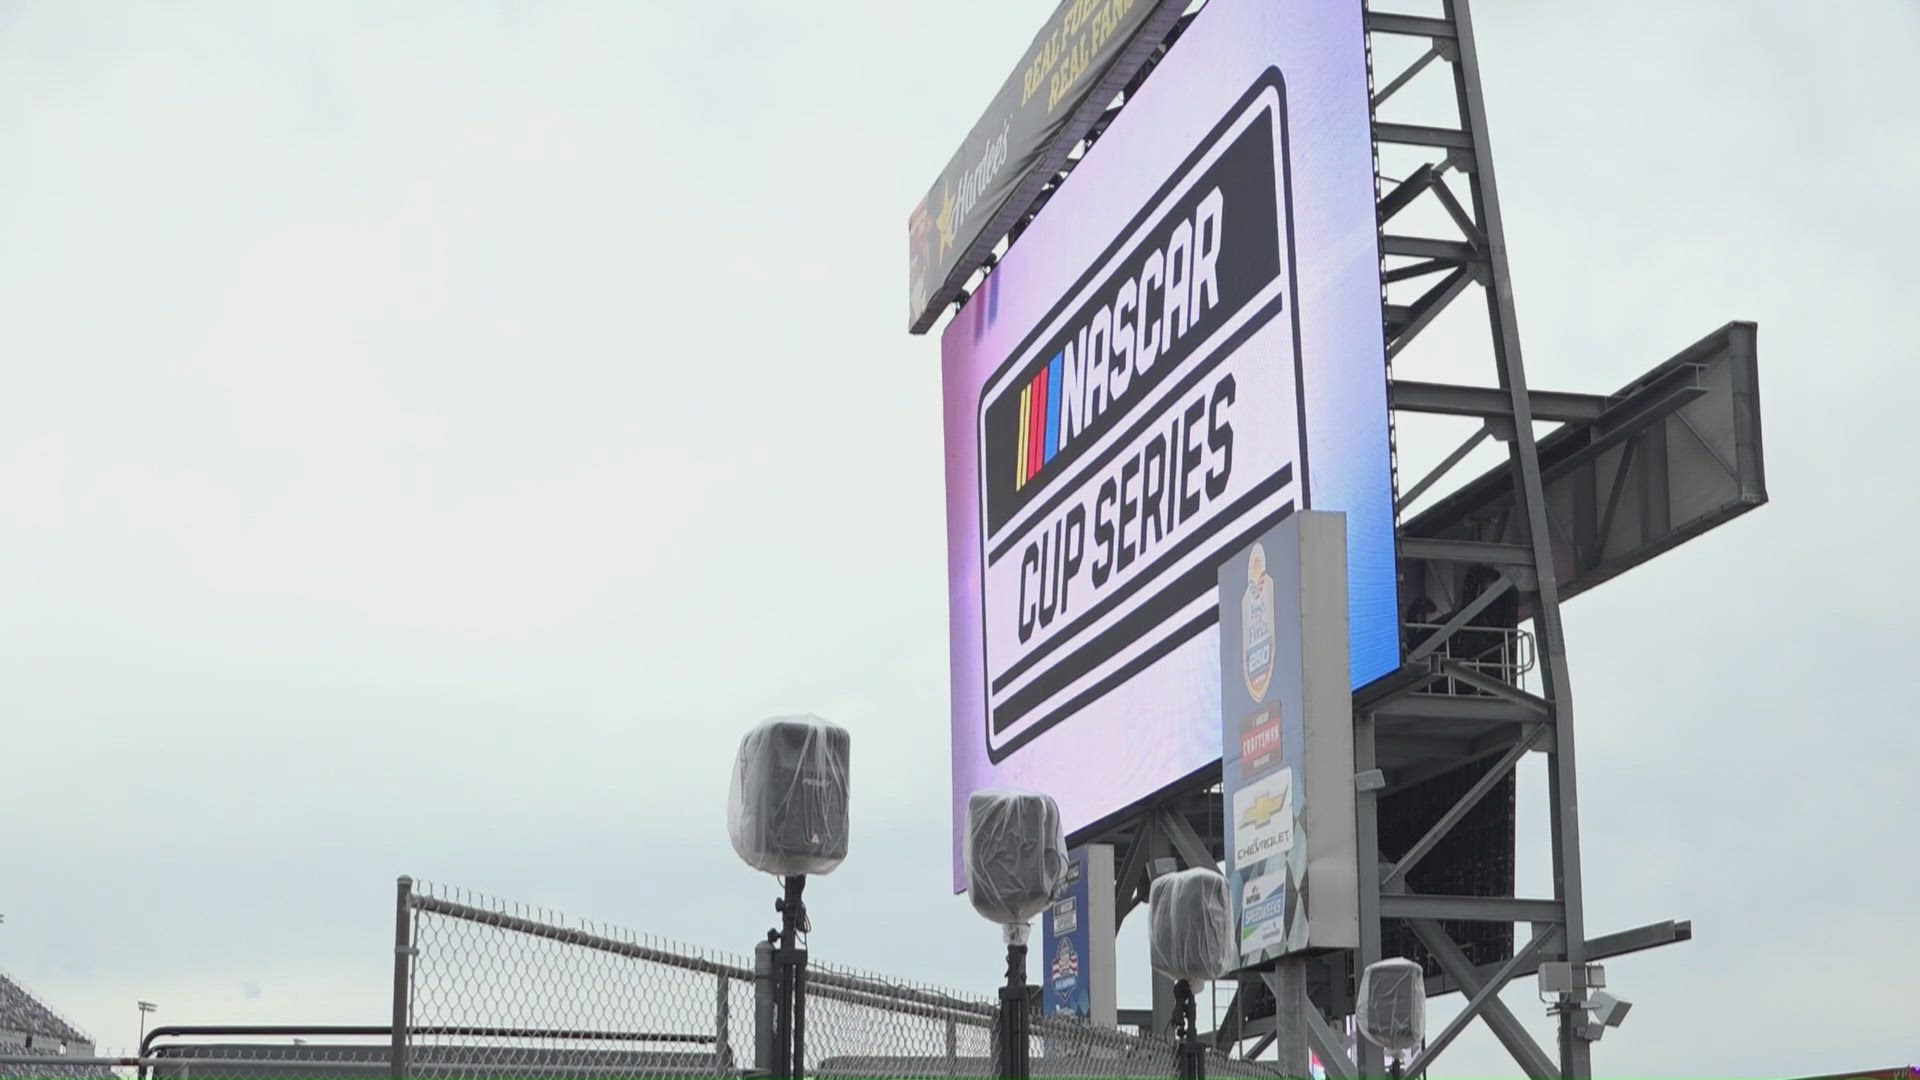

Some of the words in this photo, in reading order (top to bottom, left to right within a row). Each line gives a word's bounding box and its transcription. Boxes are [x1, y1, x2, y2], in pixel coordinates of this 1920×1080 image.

[1021, 27, 1060, 108] REAL
[1048, 32, 1090, 115] REAL
[1058, 186, 1224, 451] NASCAR
[1018, 501, 1087, 645] CUP
[1091, 371, 1237, 591] SERIES
[1248, 643, 1271, 674] 250
[1242, 724, 1280, 757] CRAFTSMAN
[1237, 829, 1290, 861] CHEVROLET
